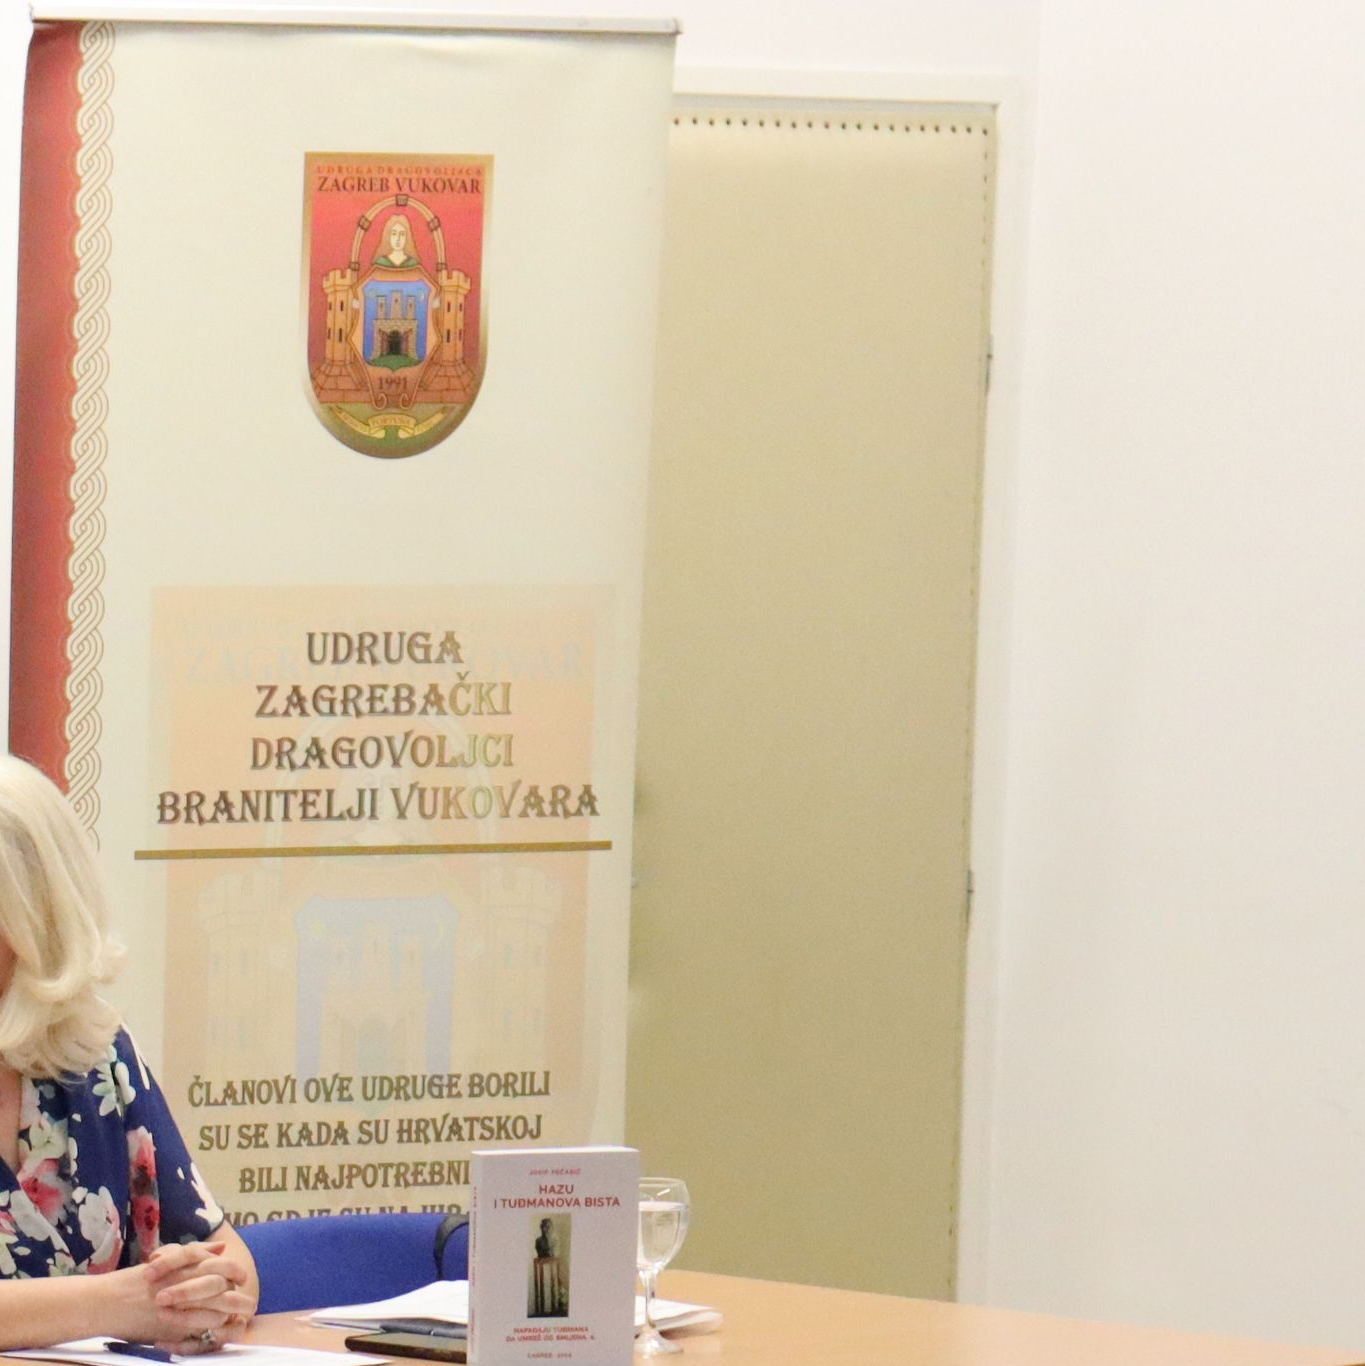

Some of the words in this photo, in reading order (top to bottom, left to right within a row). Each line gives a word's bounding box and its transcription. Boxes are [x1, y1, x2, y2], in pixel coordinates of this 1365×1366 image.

[316, 175, 390, 193] ZAGREB
[394, 176, 482, 194] VUKOVAR
[306, 629, 465, 666] UDRUGA
[254, 669, 513, 718] ZAGREBAČKI
[250, 729, 515, 771] DRAGOVOLJCI
[156, 786, 380, 825] BRANITELJI
[389, 779, 601, 822] VUKOVARA
[188, 1074, 296, 1106] ČLANOVI
[304, 1073, 352, 1103] OVE
[361, 1074, 461, 1102] UDRUGE
[468, 1071, 549, 1098] BORILI
[199, 1125, 229, 1149] SU
[237, 1123, 268, 1147] SE
[277, 1120, 349, 1146] KADA
[357, 1119, 387, 1144] SU
[397, 1113, 542, 1144] HRVATSKOJ
[238, 1166, 287, 1192] BILI
[538, 1183, 575, 1196] HAZU
[500, 1196, 582, 1210] TUĐMANOVA
[583, 1195, 621, 1209] BISTA
